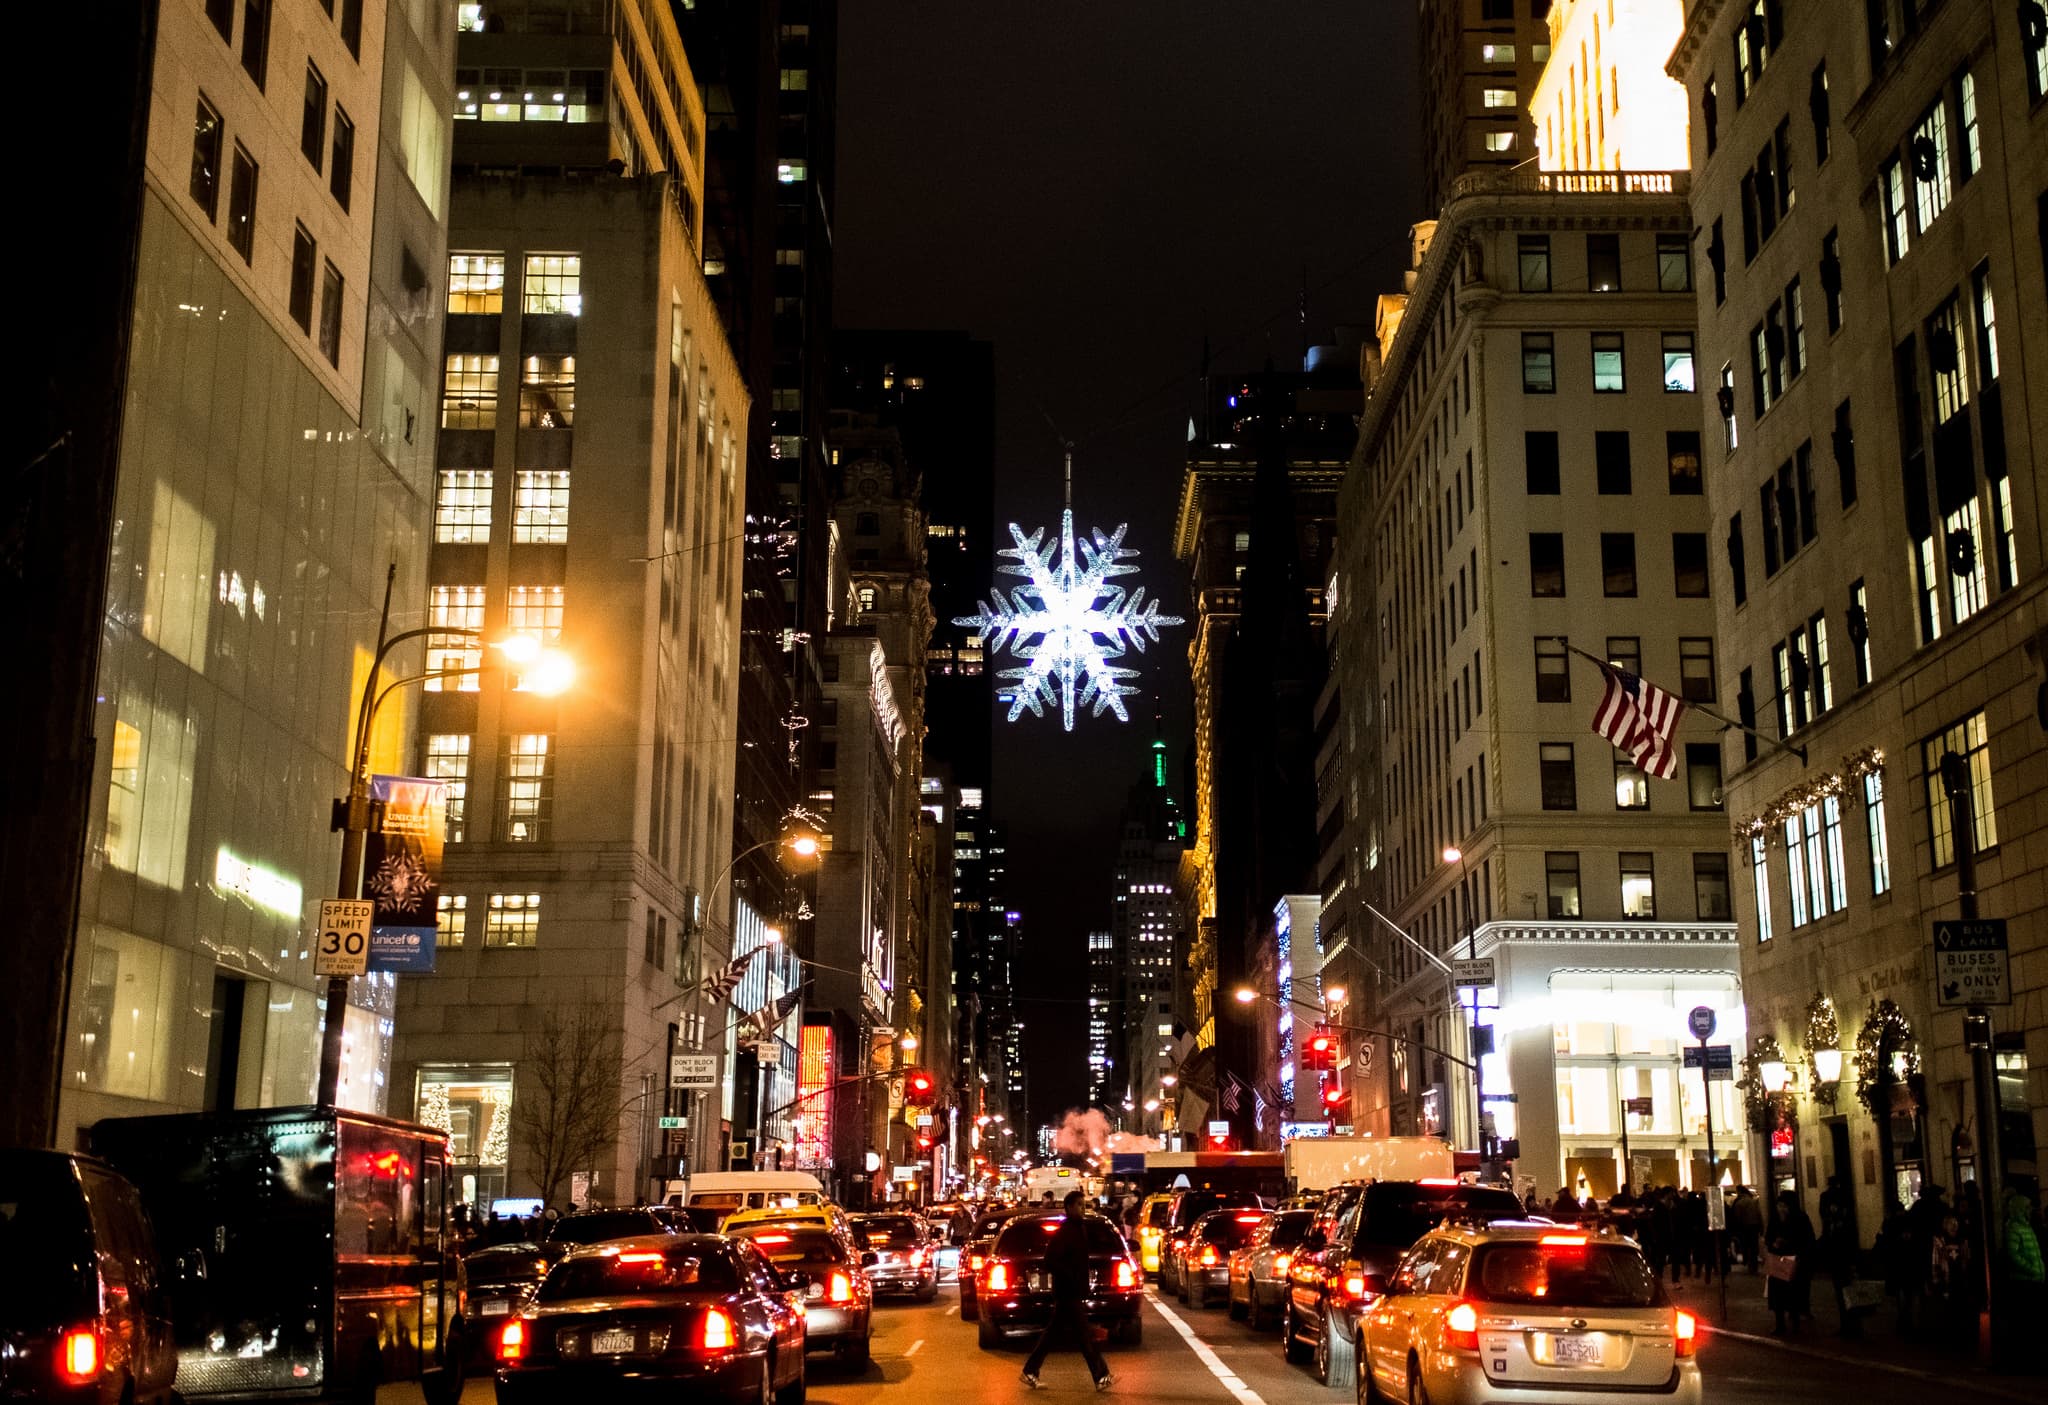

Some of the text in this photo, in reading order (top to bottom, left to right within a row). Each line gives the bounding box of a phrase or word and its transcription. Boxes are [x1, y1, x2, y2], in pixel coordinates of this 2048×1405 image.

[324, 905, 370, 917] SPEED
[327, 918, 364, 929] LIMIT
[1963, 925, 1994, 935] BUS
[322, 931, 364, 955] 30
[372, 934, 406, 945] unicef
[1960, 937, 2000, 947] LANE
[1947, 953, 1996, 966] BUSES
[1963, 975, 2001, 987] ONLY
